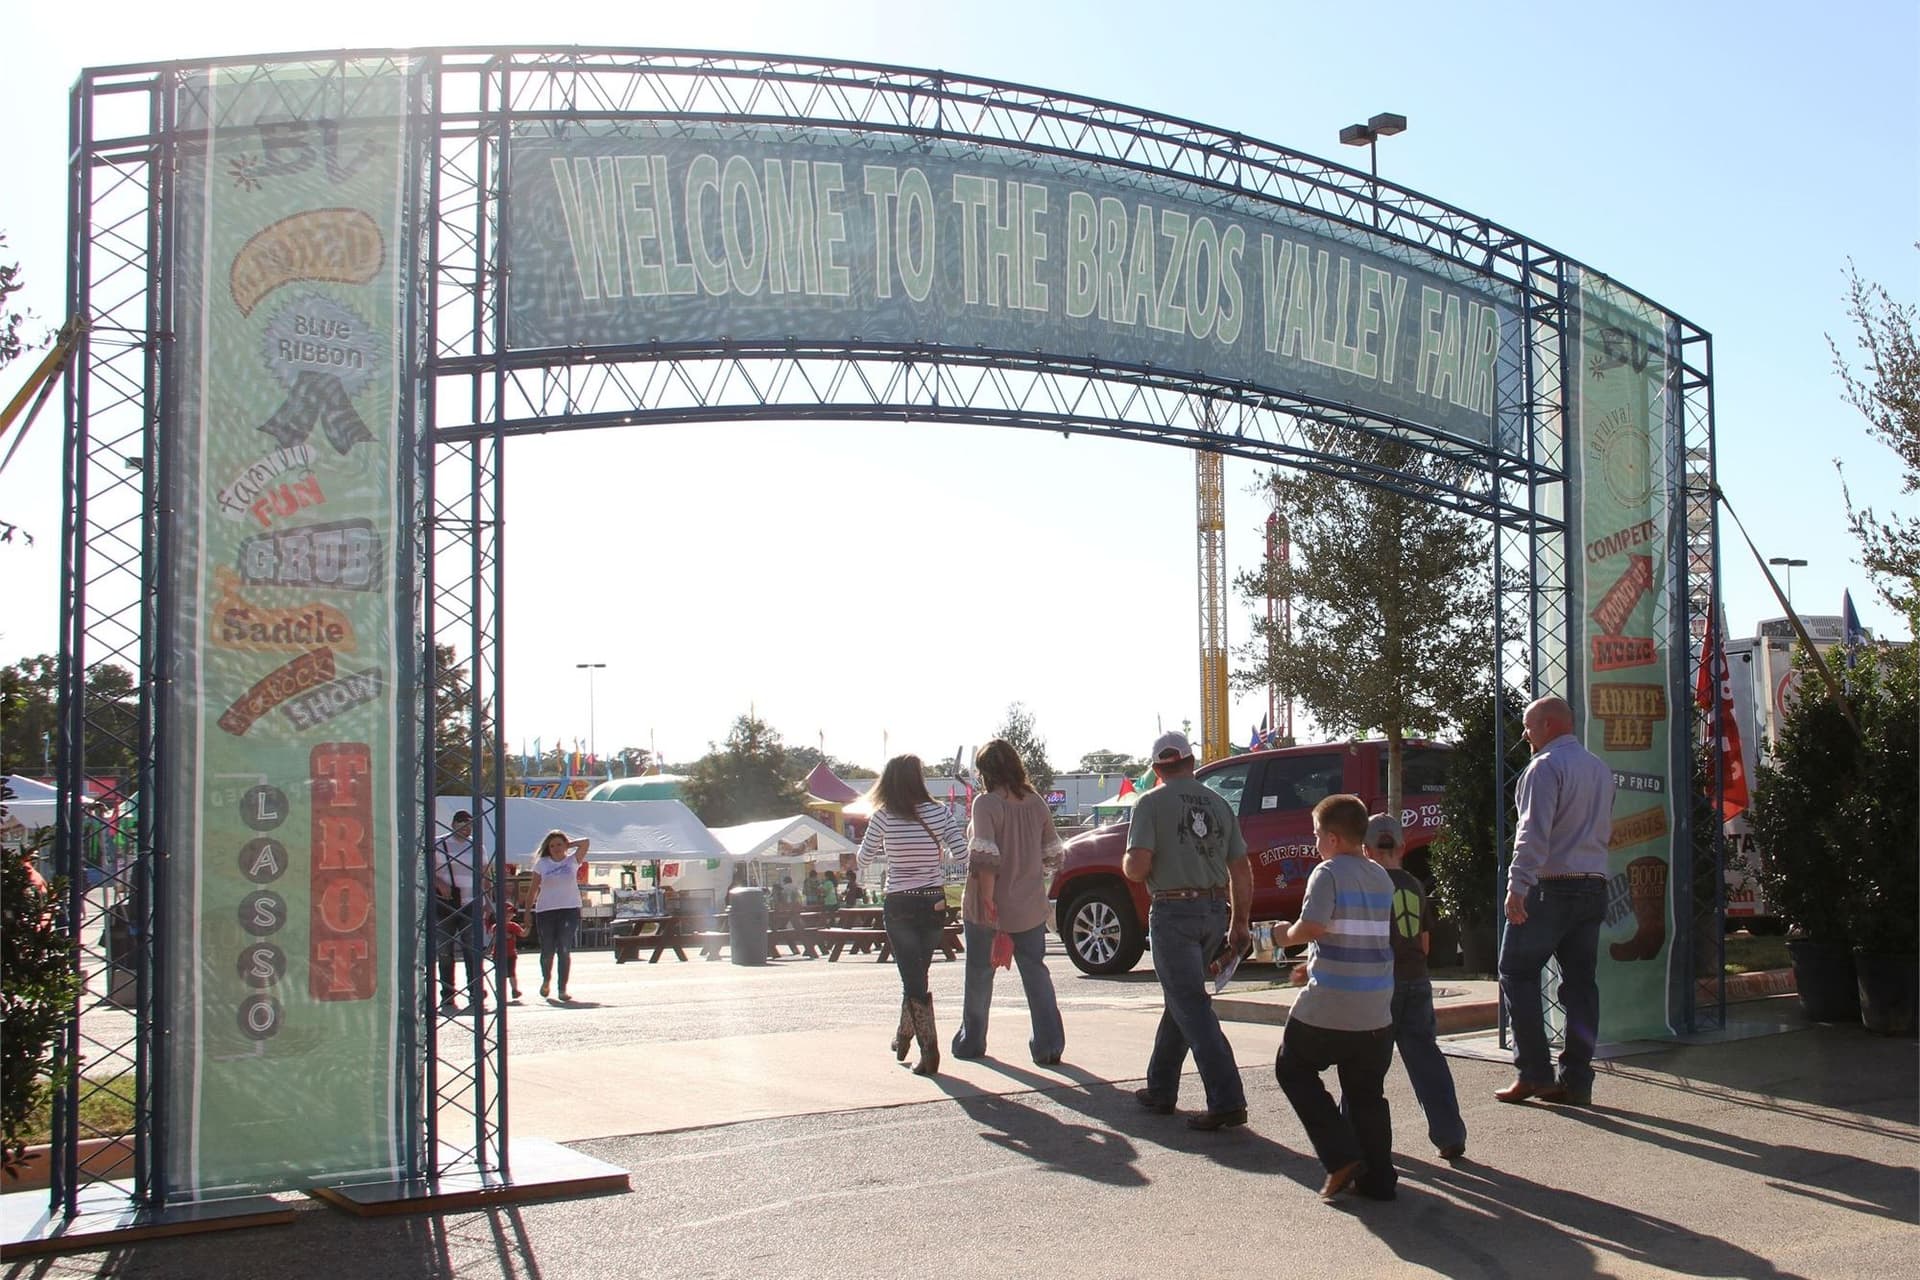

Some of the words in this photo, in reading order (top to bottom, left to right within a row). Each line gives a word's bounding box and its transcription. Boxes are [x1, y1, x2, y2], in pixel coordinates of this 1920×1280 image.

[551, 153, 851, 300] WELCOME
[864, 164, 936, 302] TO
[953, 173, 1049, 312] THE
[1065, 191, 1246, 344] BRAZOS
[1261, 233, 1407, 385] VALLEY
[1416, 285, 1500, 417] FAIR
[251, 473, 327, 528] FUN
[245, 527, 373, 586] GRUB
[222, 607, 346, 645] Saddle
[1597, 640, 1653, 665] MUSIC
[289, 673, 381, 728] SHOW
[1597, 687, 1660, 715] ADMIT
[1611, 718, 1647, 745] ALL
[1613, 773, 1625, 787] EP
[1630, 776, 1660, 791] FRIED
[1608, 817, 1665, 846] XHIBITS
[1260, 847, 1288, 866] FAIR
[316, 754, 375, 993] TROT
[1630, 865, 1666, 886] BOOT
[247, 790, 280, 1033] LASSO
